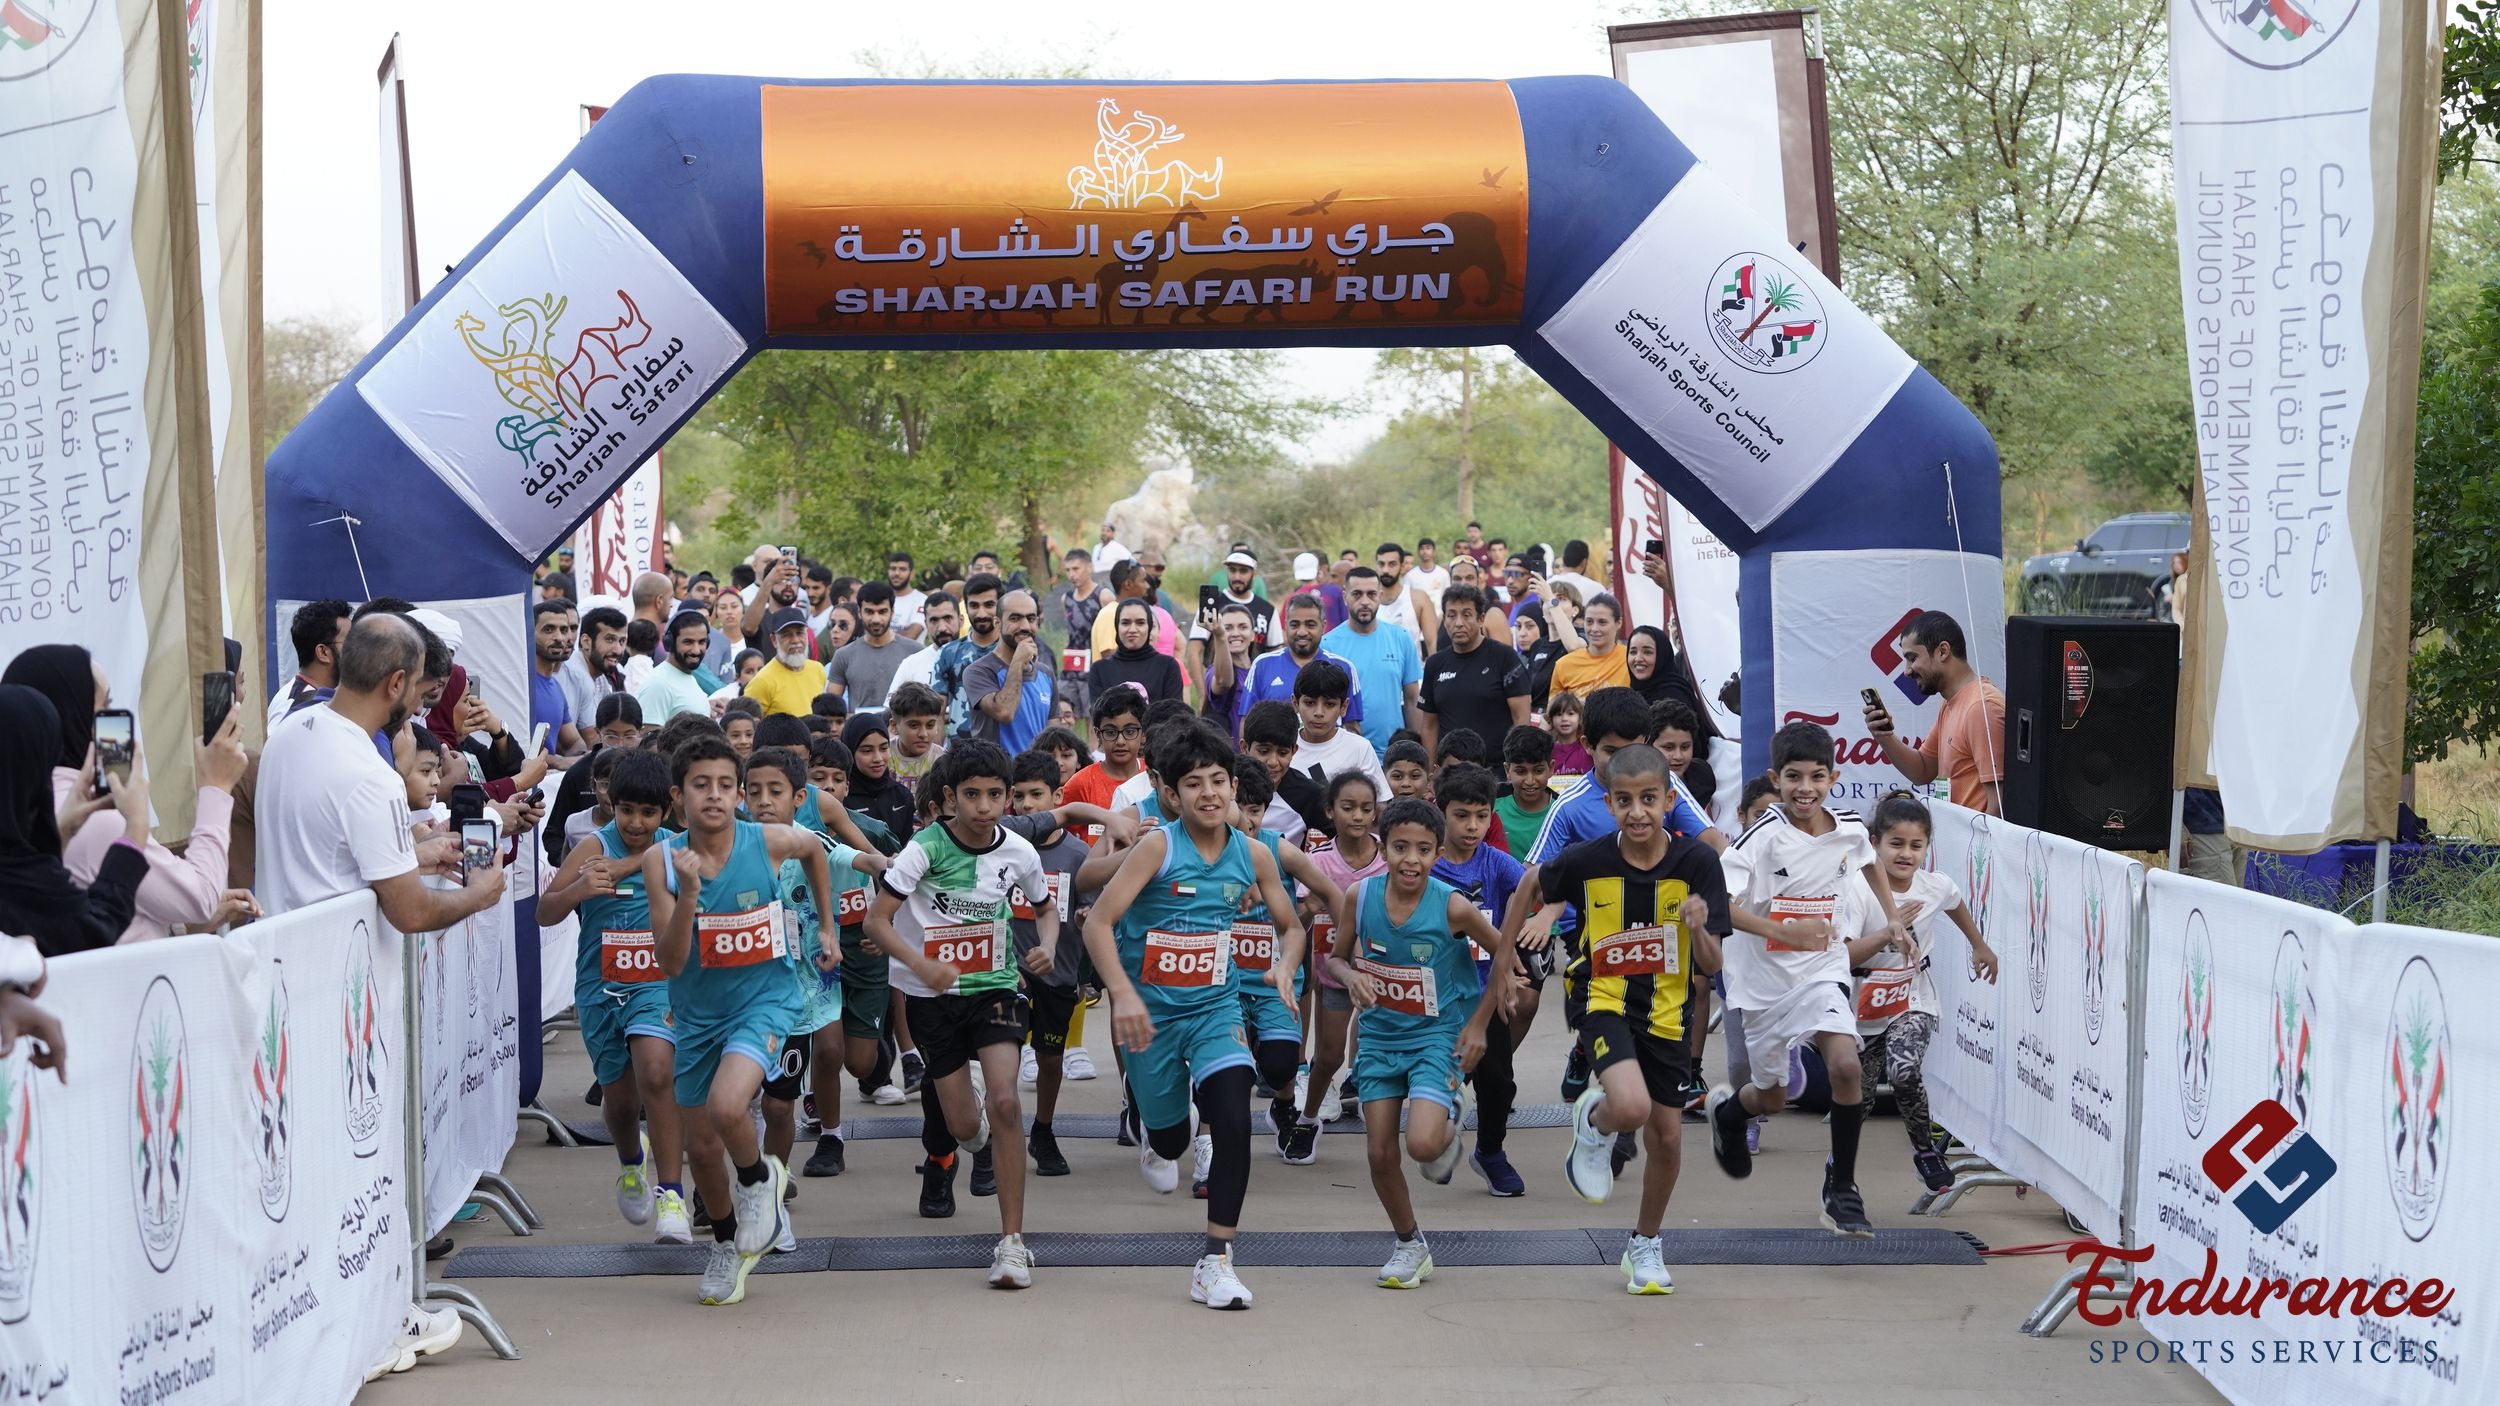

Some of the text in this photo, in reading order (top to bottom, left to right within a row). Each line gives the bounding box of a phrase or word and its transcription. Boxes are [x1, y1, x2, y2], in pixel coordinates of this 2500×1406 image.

[833, 216, 1455, 272] جري سفاري الشارقة
[834, 272, 1452, 315] SHARJAH SAFARI RUN
[1627, 308, 1784, 445] مجلس الشارقة الرياضي
[1615, 319, 1771, 463] Sharjah Sports Council
[520, 335, 685, 498] سفاري الشارقة
[544, 431, 628, 510] Sharjah
[628, 360, 695, 427] Safari
[633, 480, 650, 572] PORTS
[1830, 782, 1899, 799] ORTS
[949, 906, 997, 918] chartered
[951, 897, 997, 910] standard
[715, 926, 772, 954] 803
[938, 939, 989, 963] 801
[1230, 937, 1272, 958] 808
[1606, 942, 1664, 965] 843
[1158, 951, 1215, 974] 805
[1374, 977, 1424, 1003] 804
[1870, 982, 1910, 1008] 829
[289, 1281, 320, 1322] Council
[154, 1366, 181, 1406] Sports
[184, 1346, 215, 1387] Council
